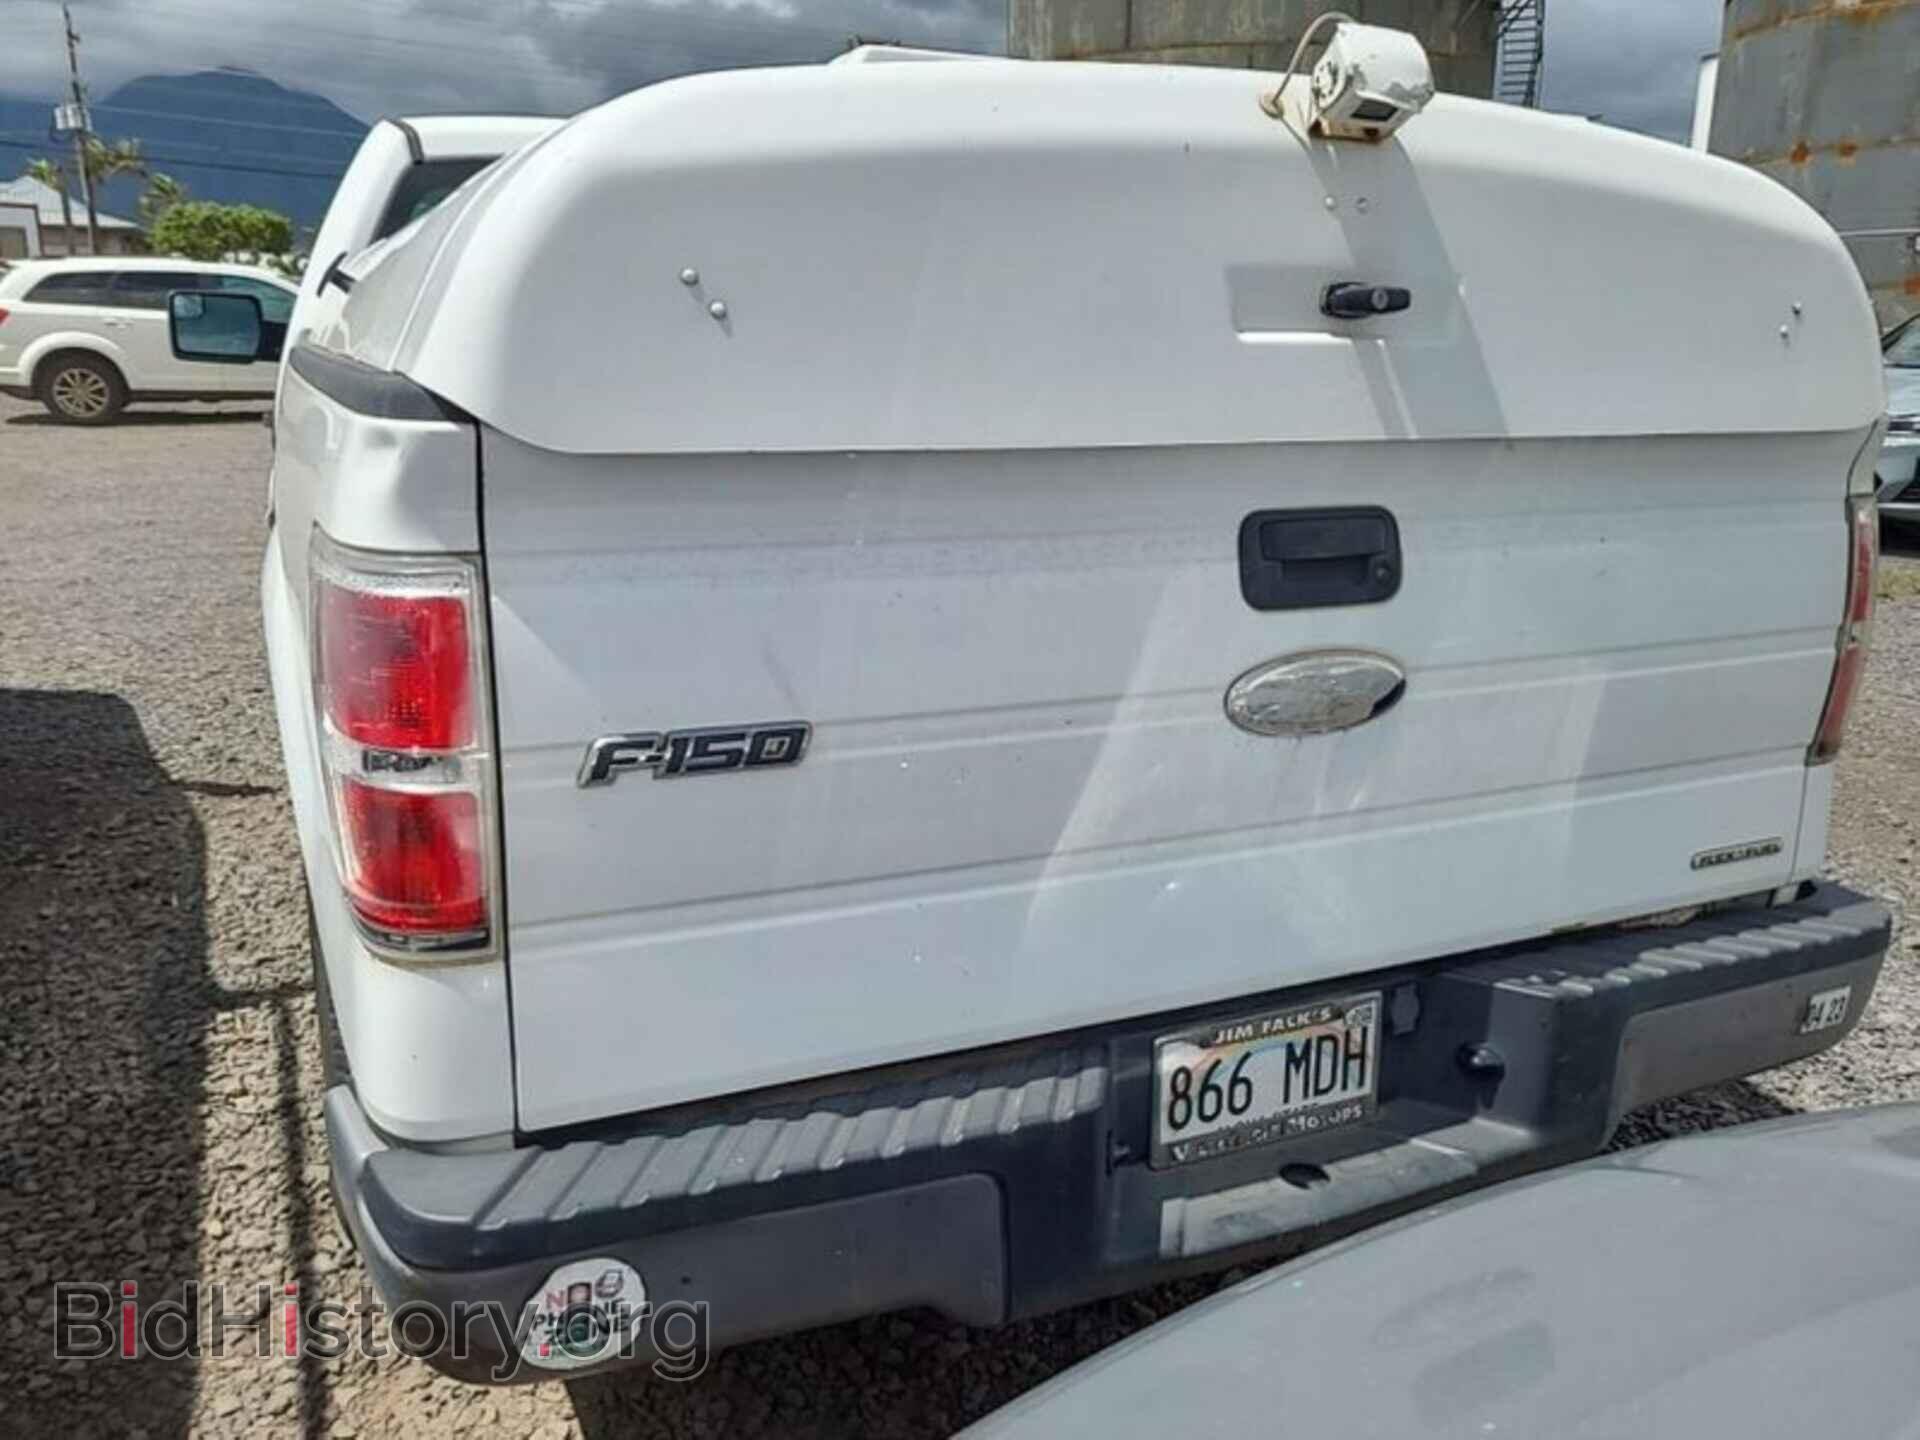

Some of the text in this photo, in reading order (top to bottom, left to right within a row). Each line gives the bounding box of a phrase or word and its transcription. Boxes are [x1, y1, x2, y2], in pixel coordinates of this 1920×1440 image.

[577, 720, 812, 788] F-150
[1214, 1025, 1254, 1044] JIM
[1261, 1007, 1332, 1034] FALK'S
[1167, 1026, 1368, 1131] 866 MDH
[533, 1297, 626, 1331] PHNE
